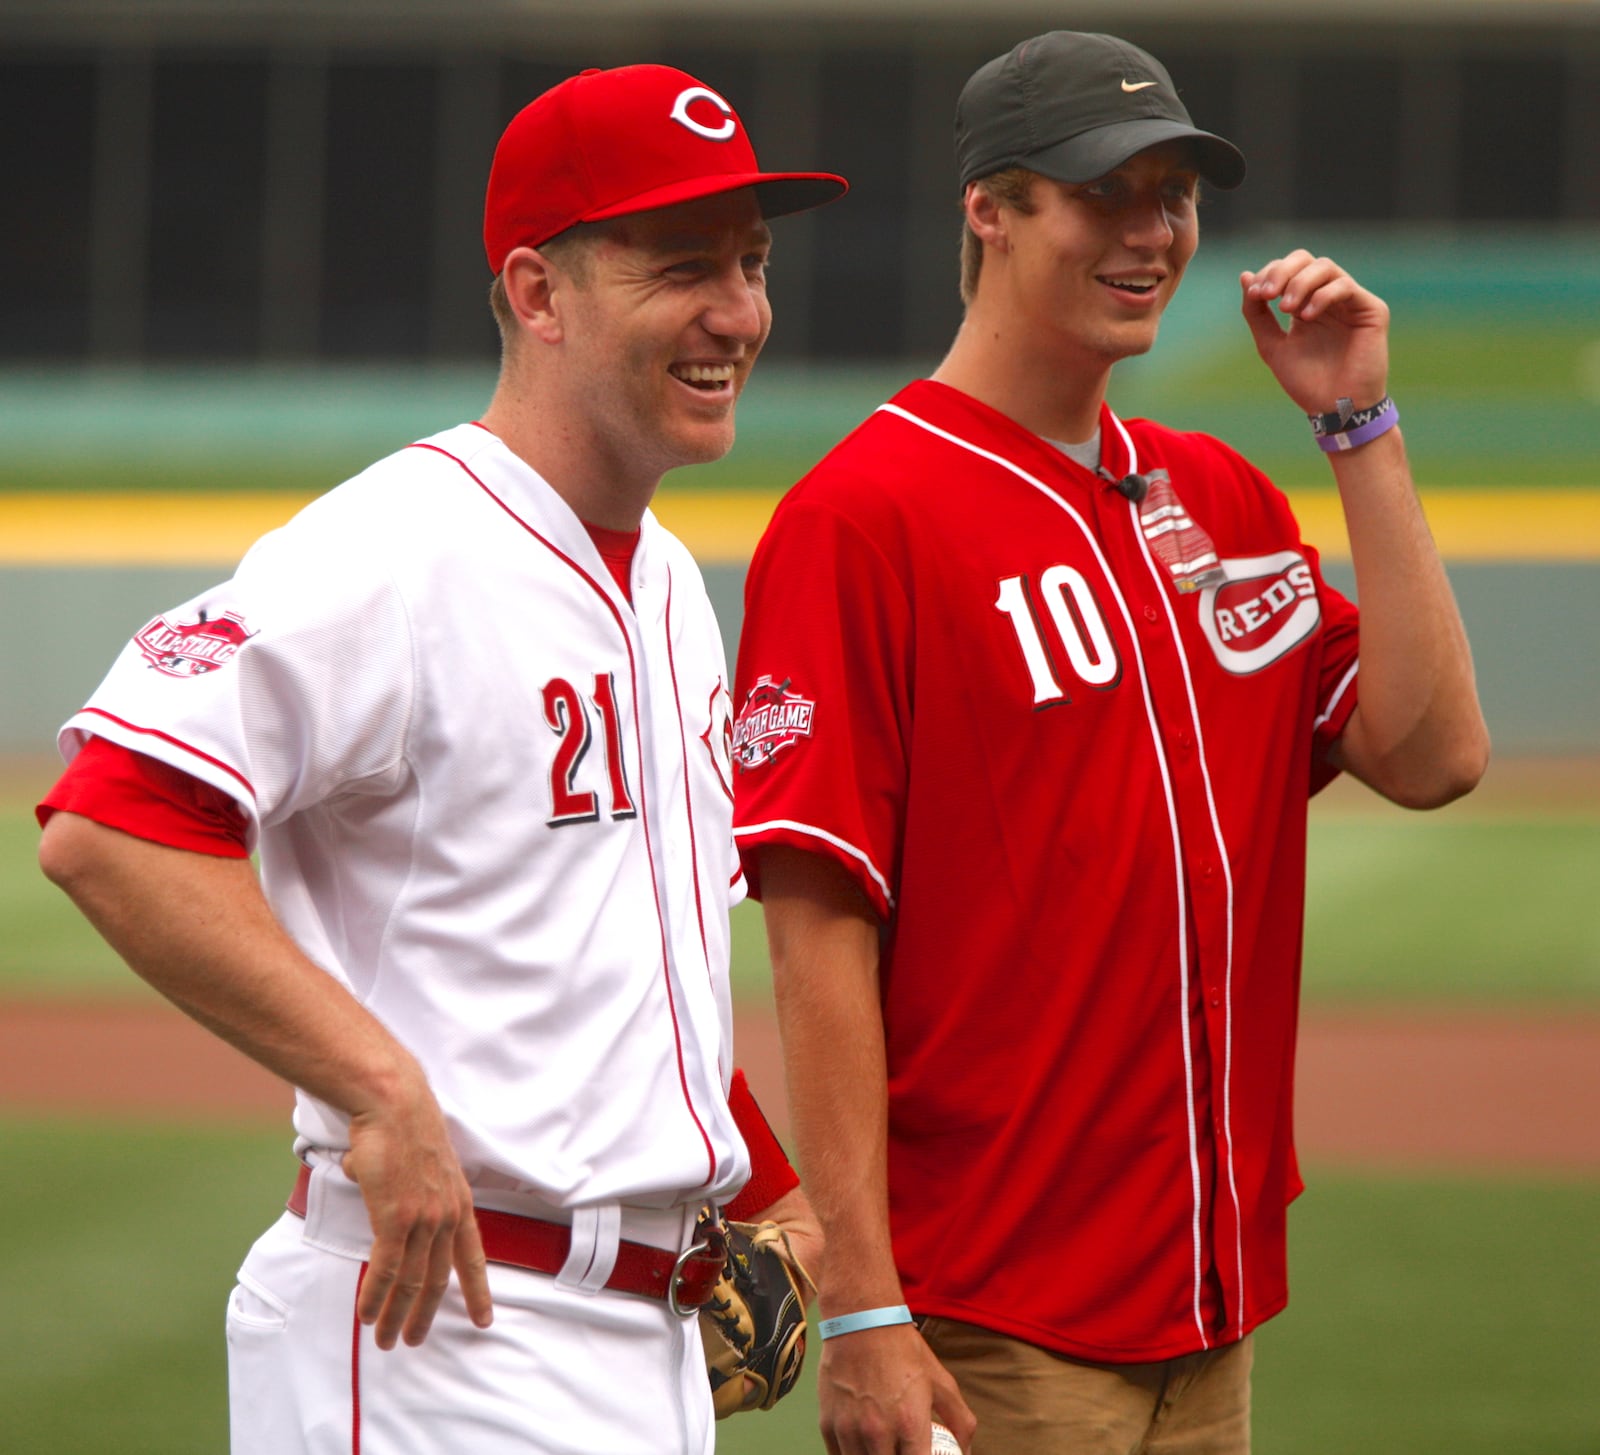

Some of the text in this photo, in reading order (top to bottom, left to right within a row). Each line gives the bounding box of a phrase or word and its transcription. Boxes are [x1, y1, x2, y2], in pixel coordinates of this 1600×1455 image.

[669, 86, 736, 143] C
[993, 563, 1123, 712] 10
[1215, 563, 1317, 642] REDS
[538, 671, 637, 829] 21
[768, 703, 810, 730] GAME
